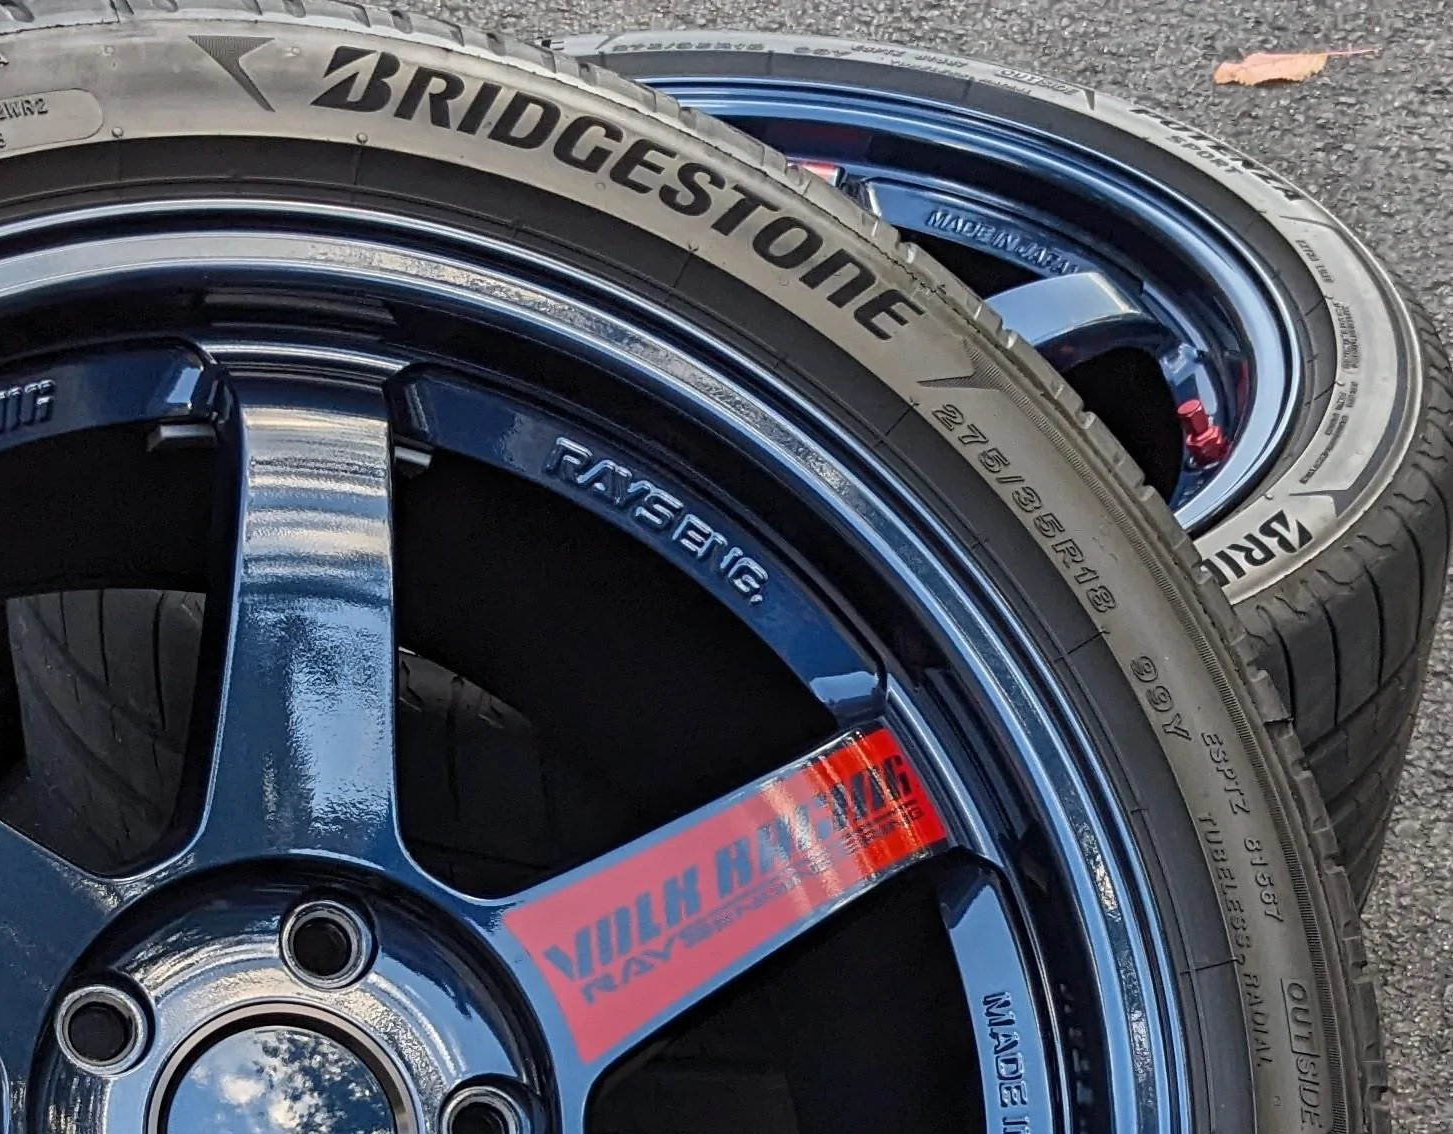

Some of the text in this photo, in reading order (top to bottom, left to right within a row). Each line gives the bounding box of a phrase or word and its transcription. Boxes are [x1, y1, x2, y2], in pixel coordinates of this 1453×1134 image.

[310, 45, 927, 342] BRIDGESTONE
[925, 208, 989, 242] MADE
[990, 227, 1018, 254] IN
[545, 434, 686, 530] RAYS
[930, 401, 1119, 615] 275/35R18
[1128, 652, 1193, 745] 99Y
[1198, 725, 1286, 929] ESPTZ 81567
[543, 863, 703, 982] VOLK
[1195, 810, 1275, 1069] TUBELESS RADIAL
[981, 990, 1028, 1109] MADE
